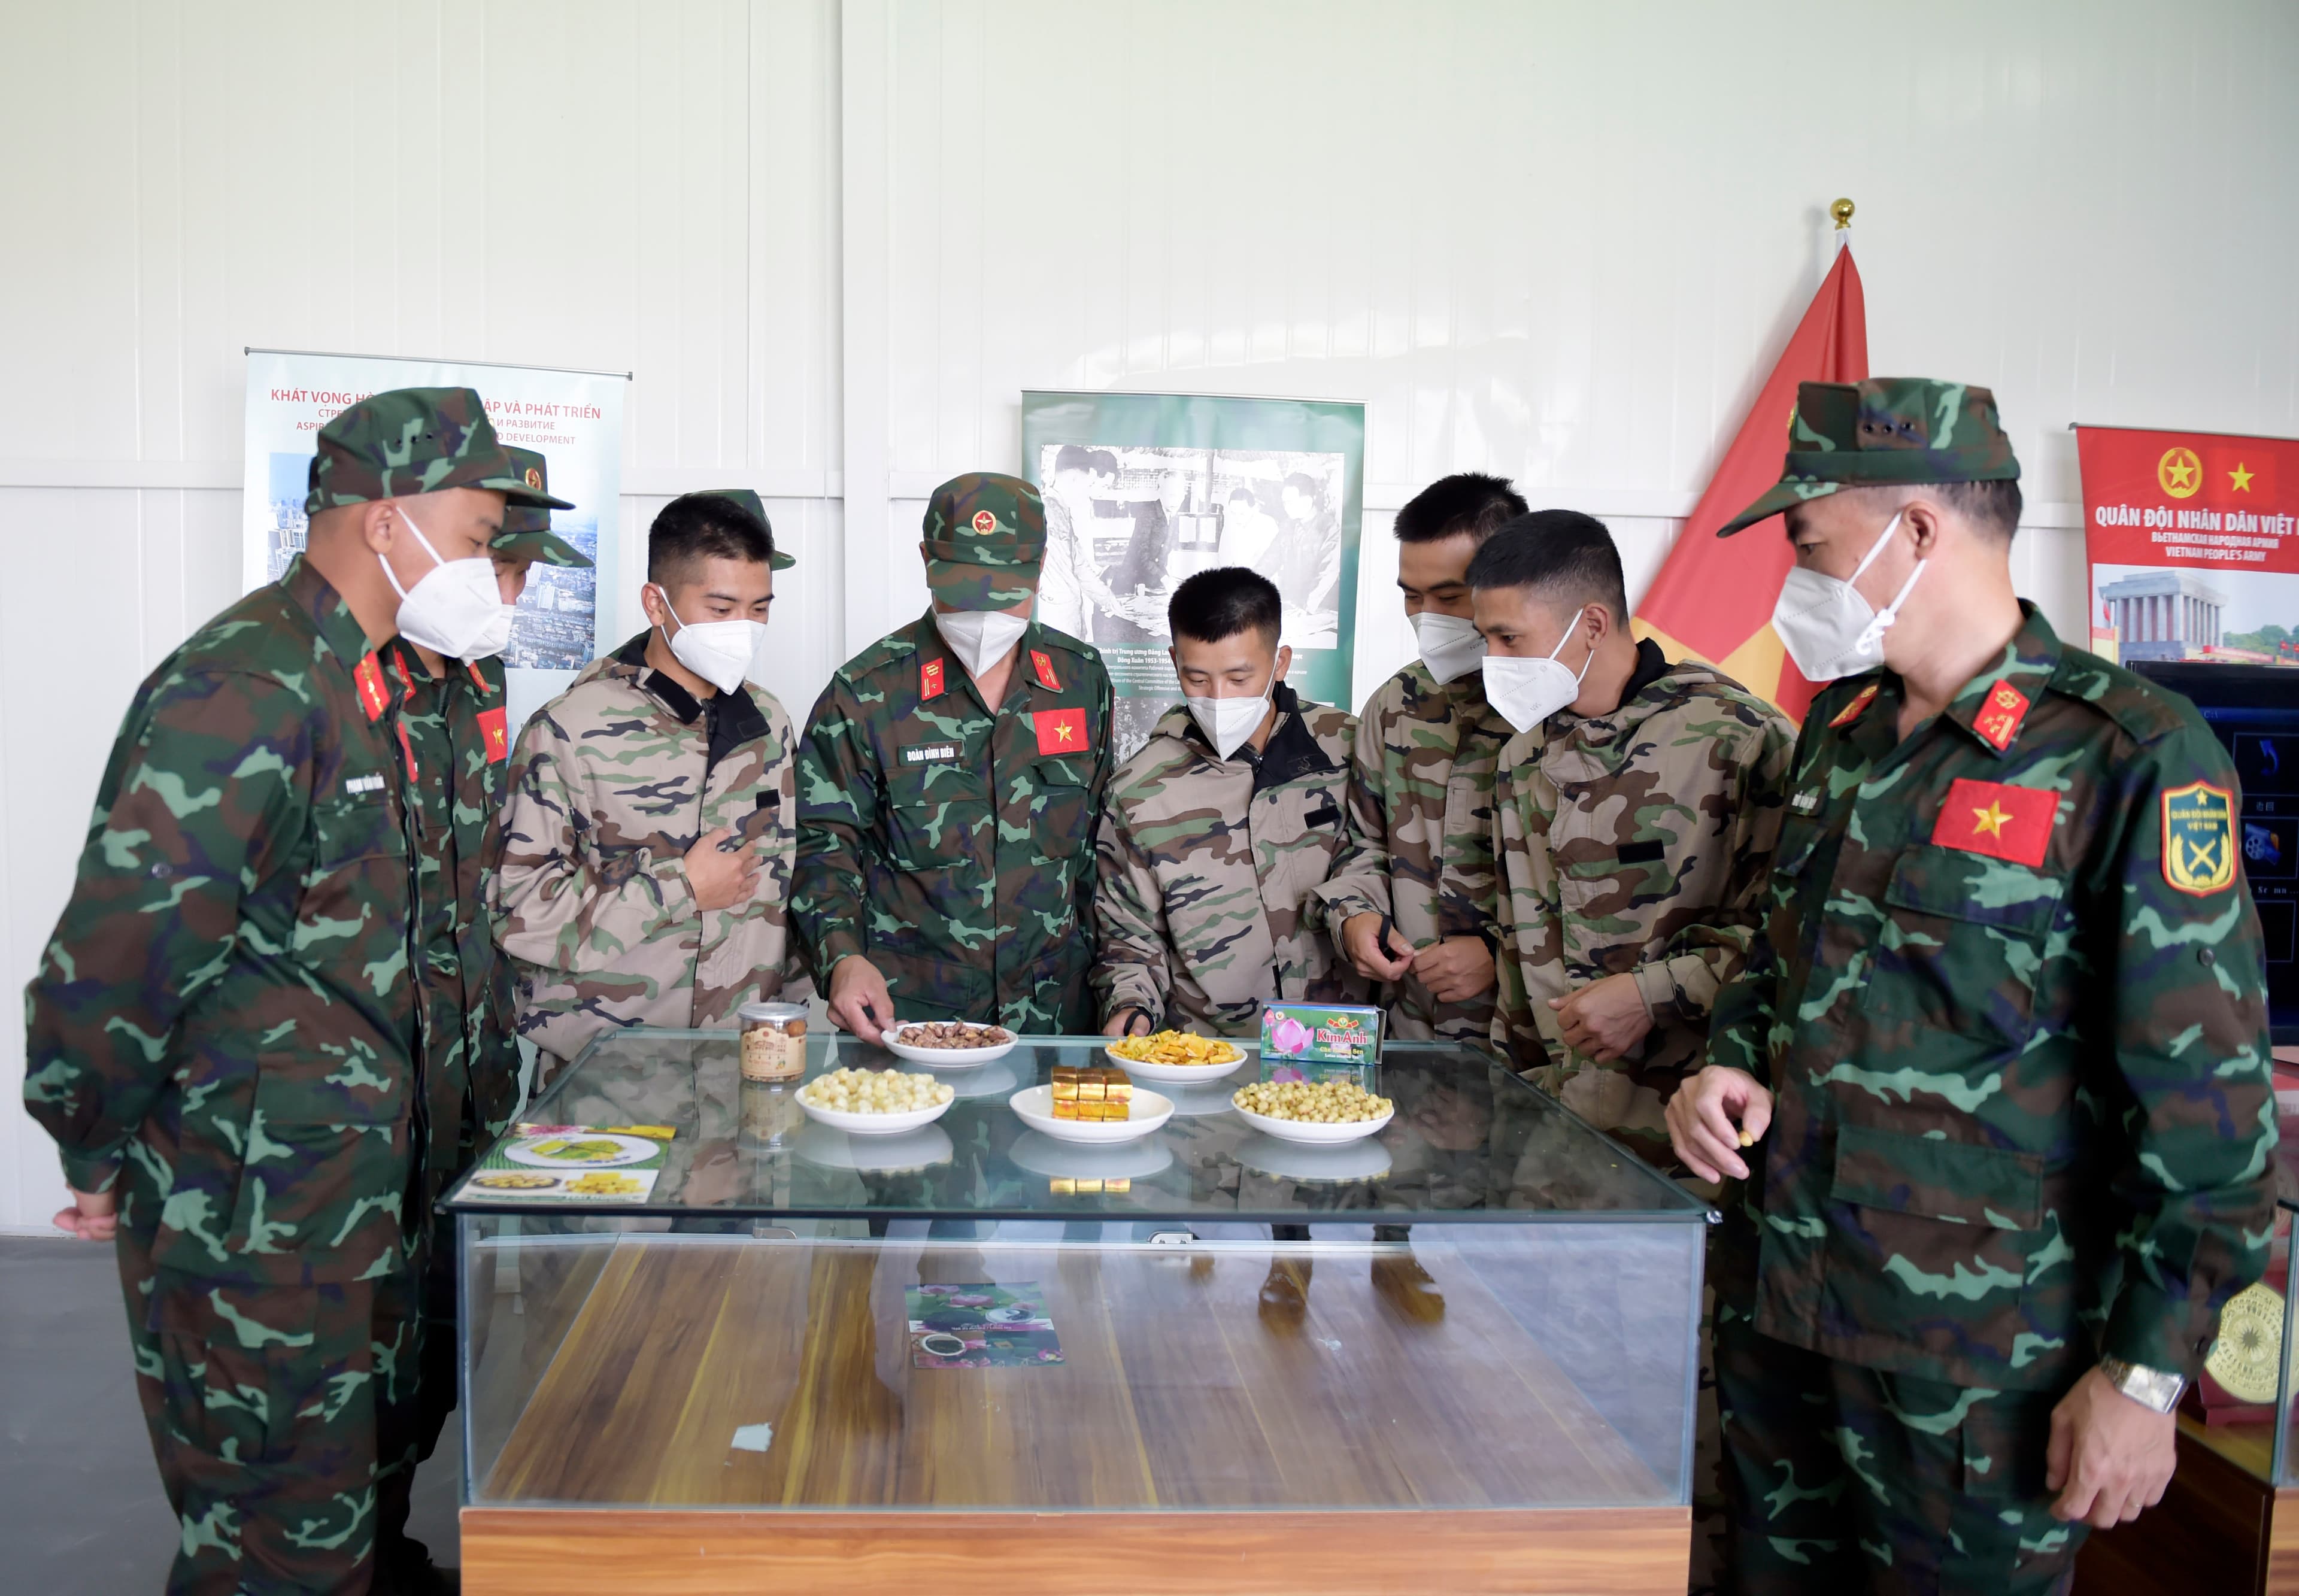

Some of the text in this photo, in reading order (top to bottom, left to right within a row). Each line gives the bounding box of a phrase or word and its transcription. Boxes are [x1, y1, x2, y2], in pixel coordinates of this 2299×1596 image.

[271, 388, 308, 402] KHÁT
[311, 391, 351, 406] VỌNG
[504, 400, 521, 414] VÀ
[525, 402, 560, 417] PHÁT
[563, 403, 601, 419] TRIỂN
[506, 419, 555, 430] РАЗВИТИЕ
[506, 433, 576, 445] DEVELOPMENT
[2095, 503, 2140, 527] QUÂN
[2143, 505, 2173, 530] ĐỘI
[2177, 508, 2221, 530] NHÂN
[2225, 510, 2258, 533] DÂN
[2261, 512, 2294, 538] VIỆT
[1317, 1029, 1367, 1045] Kim Anh
